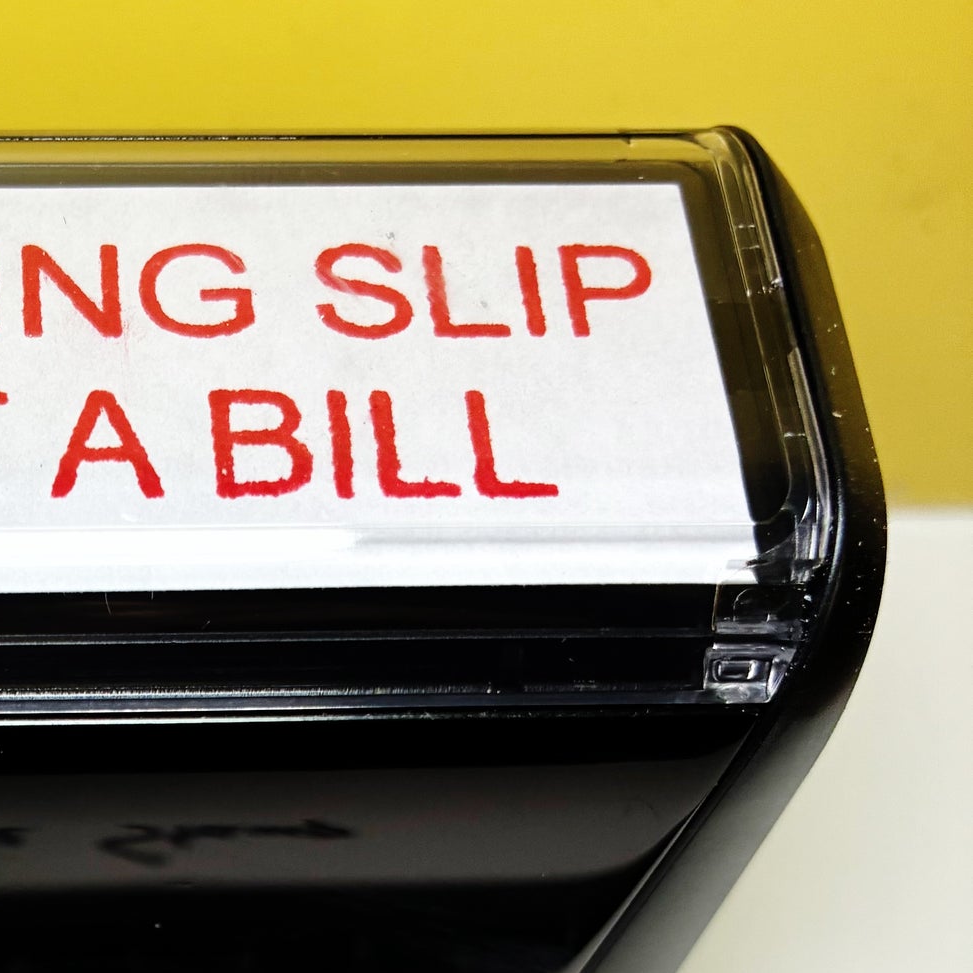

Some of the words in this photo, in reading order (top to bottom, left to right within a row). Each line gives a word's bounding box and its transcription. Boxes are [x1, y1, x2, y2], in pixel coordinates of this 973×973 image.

[314, 242, 653, 340] SLIP
[50, 389, 166, 500] A
[207, 388, 560, 500] BILL
